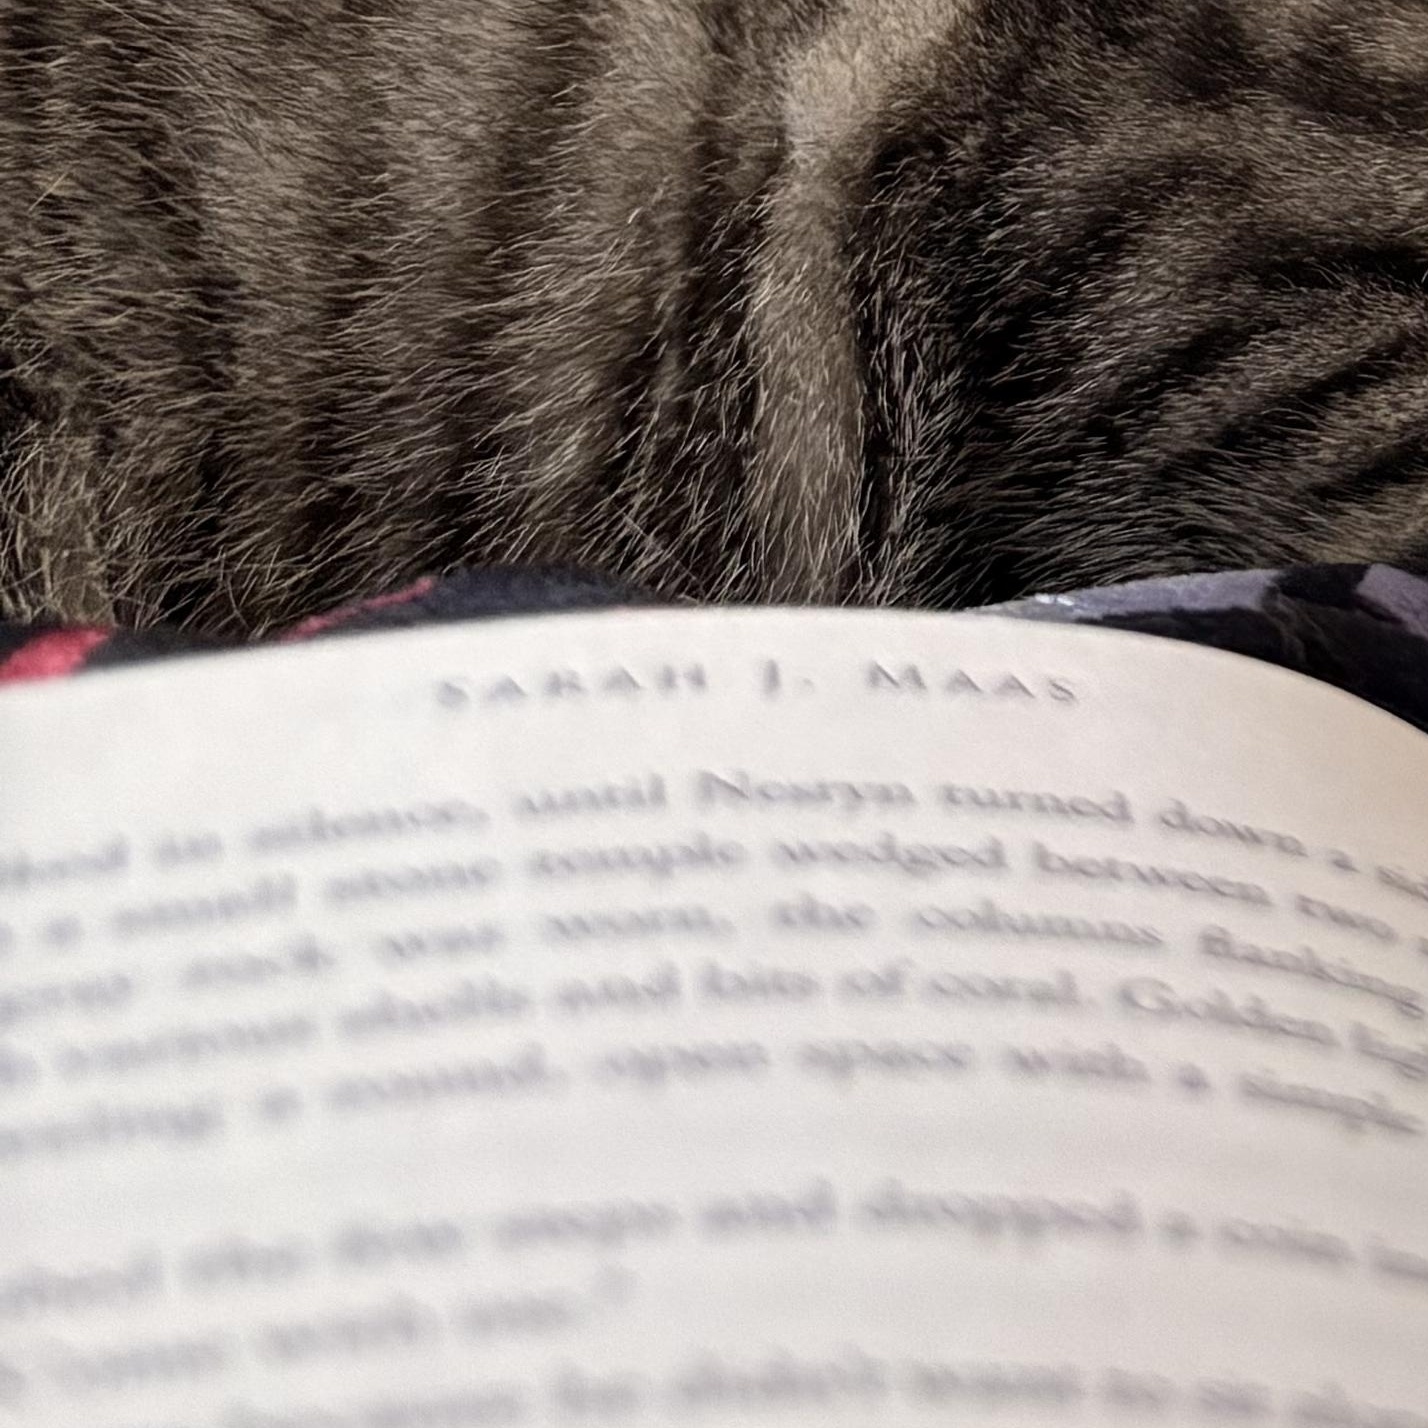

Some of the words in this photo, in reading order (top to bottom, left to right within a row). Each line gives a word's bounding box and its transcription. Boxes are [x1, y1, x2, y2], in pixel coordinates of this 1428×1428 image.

[437, 665, 707, 710] SARAH
[763, 660, 813, 699] J.
[865, 662, 1078, 707] MAAS
[513, 774, 668, 820] until
[694, 770, 917, 817] Nesryn
[936, 784, 1135, 830] turned
[1152, 800, 1310, 860] down
[1326, 850, 1361, 875] a
[525, 832, 748, 882] temple
[769, 832, 1011, 880] wedged
[1030, 841, 1275, 913] between
[1292, 893, 1401, 947] two
[768, 893, 875, 935] the
[905, 899, 1168, 954] columns
[553, 963, 681, 1016] and
[699, 963, 822, 1003] bits
[837, 959, 912, 1002] of
[922, 971, 1097, 1013] coral.
[1112, 978, 1341, 1056] Golden
[796, 1042, 974, 1082] space
[1001, 1044, 1152, 1086] with
[1172, 1064, 1213, 1100] a
